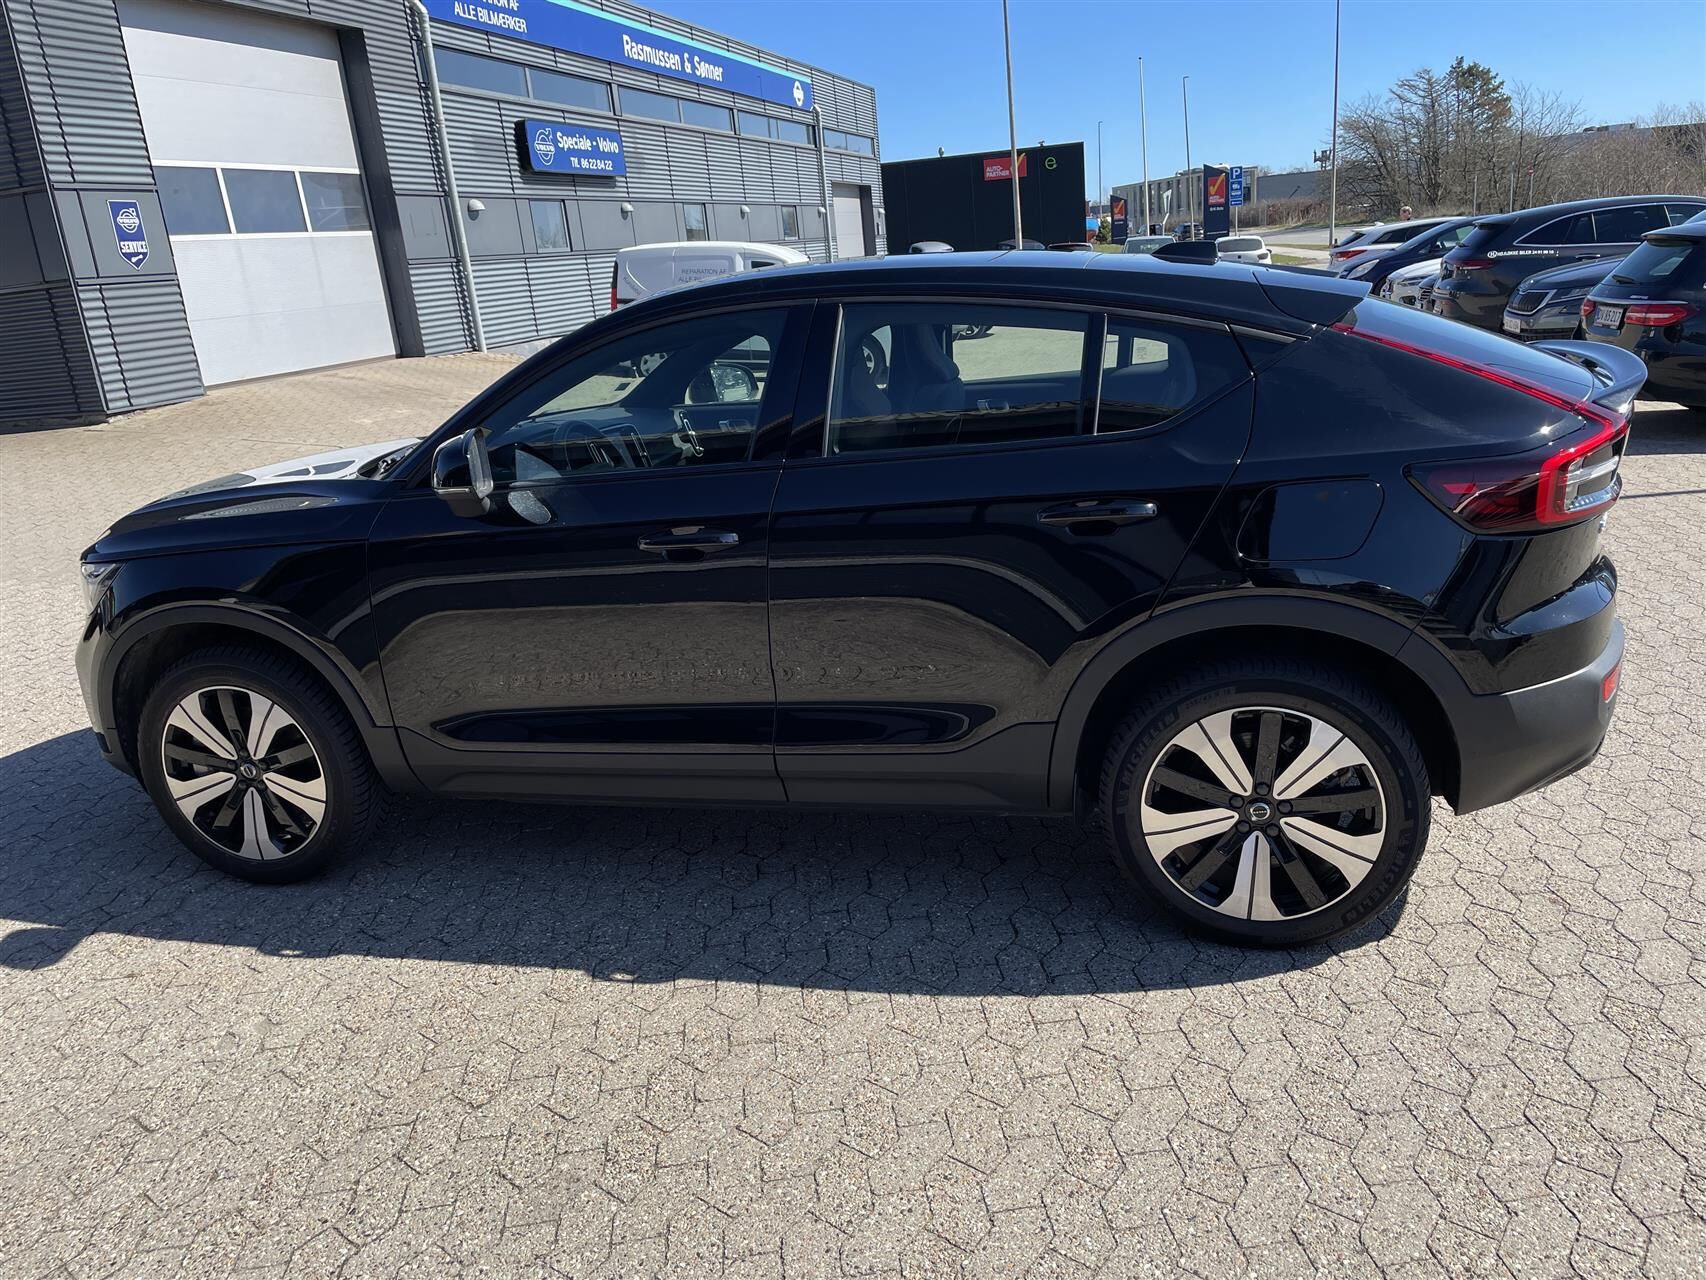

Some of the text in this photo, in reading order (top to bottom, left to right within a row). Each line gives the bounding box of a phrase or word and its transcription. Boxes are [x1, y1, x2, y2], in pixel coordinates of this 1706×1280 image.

[454, 0, 528, 33] ALLE BILMÆRKER
[622, 34, 723, 82] Rasmussen & Sønner
[535, 144, 555, 152] VOLVO
[557, 132, 592, 151] Speciale
[597, 137, 619, 153] Volvo
[986, 170, 1010, 178] PARTNER
[1233, 168, 1241, 179] P
[120, 241, 148, 253] SERVICE
